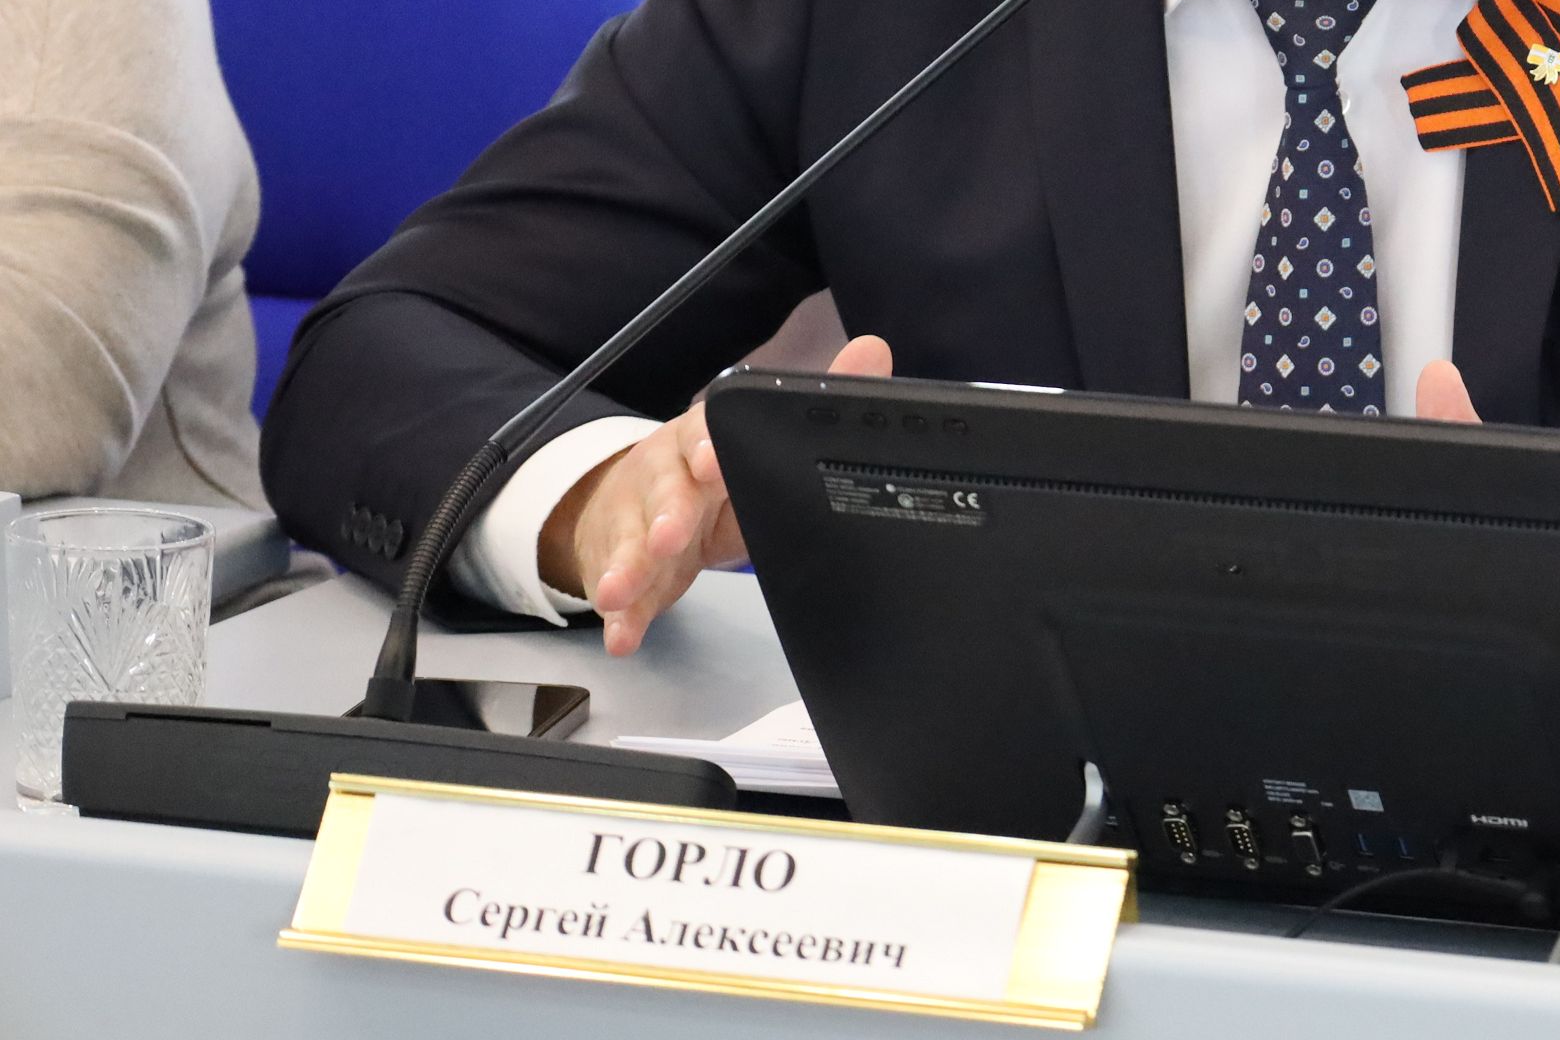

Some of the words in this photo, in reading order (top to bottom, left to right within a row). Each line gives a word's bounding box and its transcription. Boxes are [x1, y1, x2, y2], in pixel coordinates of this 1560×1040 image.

[1470, 814, 1529, 828] HDMI
[583, 832, 797, 893] ГОРЛО
[443, 887, 609, 940] Сергей
[620, 908, 909, 970] Алексеевич
